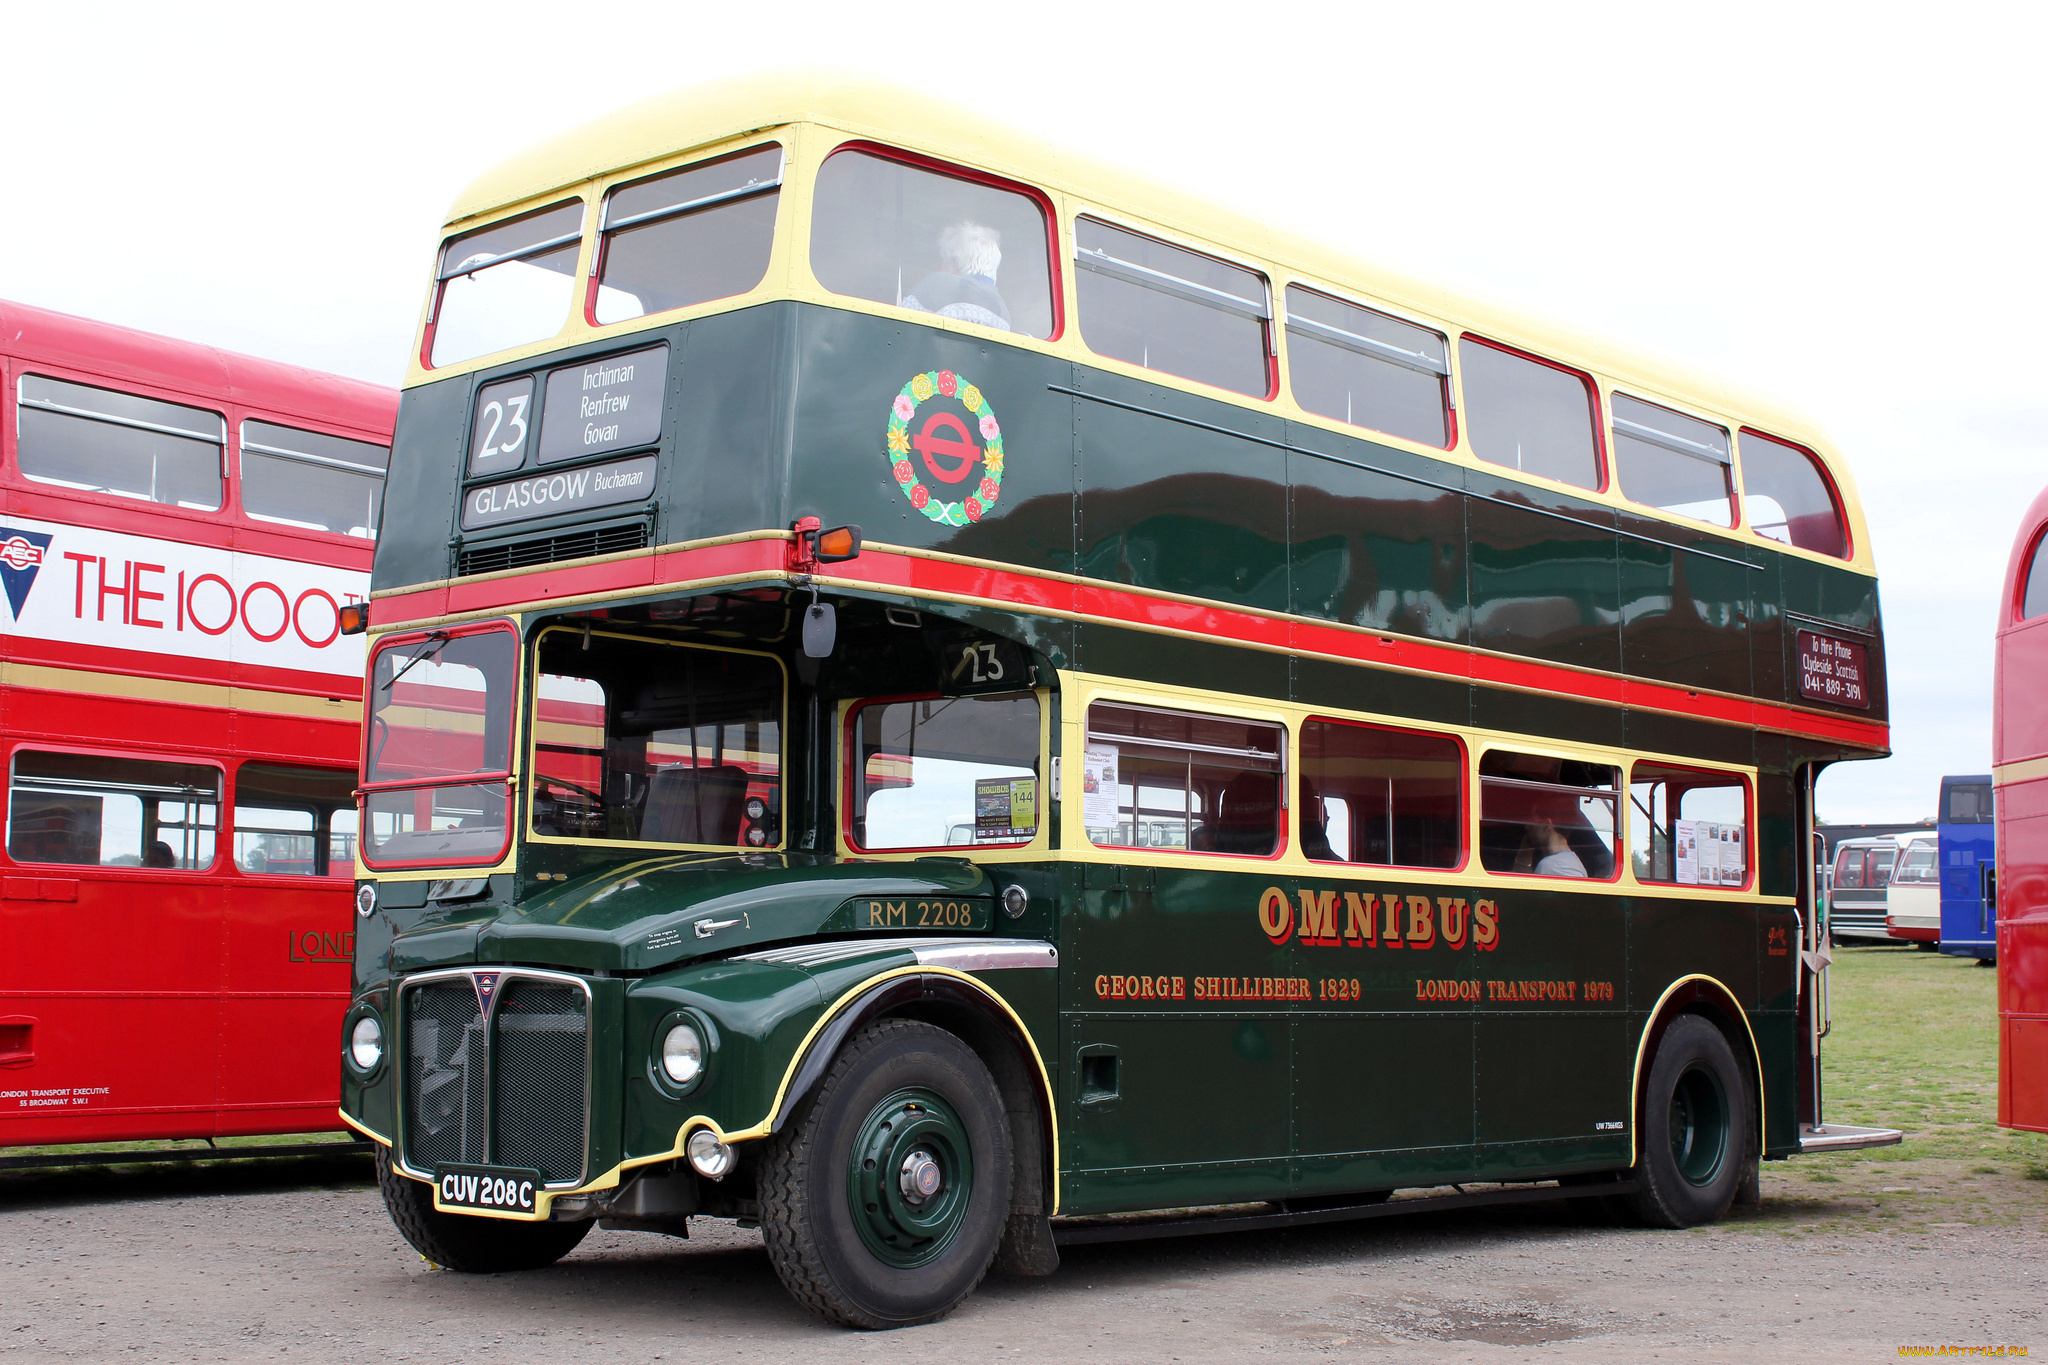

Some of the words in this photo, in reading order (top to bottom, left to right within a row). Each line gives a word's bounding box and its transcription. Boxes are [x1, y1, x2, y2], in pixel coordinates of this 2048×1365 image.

[582, 365, 634, 391] Inchinnan
[580, 392, 631, 418] Renfrew
[478, 394, 529, 458] 23
[584, 422, 619, 445] Govan
[475, 470, 591, 514] GLASGOW
[594, 470, 643, 492] Buchanan
[0, 545, 39, 562] AEC
[63, 551, 165, 629] THE
[1812, 635, 1818, 652] To
[1820, 638, 1832, 656] Hire
[1834, 640, 1852, 659] Phone
[962, 643, 1004, 683] 23
[1802, 653, 1833, 675] Clydeside
[1835, 660, 1859, 681] Scottish
[977, 784, 1010, 795] SHOWBUS
[1013, 791, 1034, 804] 144
[869, 901, 907, 926] RM
[918, 902, 971, 927] 2208
[1258, 886, 1498, 951] OMNIBUS
[1095, 975, 1186, 1000] GEORGE
[1194, 976, 1312, 1001] SHILLIBEER
[1319, 978, 1361, 1001] 1829
[1416, 980, 1482, 1001] LONDON
[1487, 980, 1577, 1001] TRANSPORT
[1583, 981, 1614, 1001] 1979
[29, 1098, 69, 1106] BROADWAY
[31, 1088, 71, 1097] TRANSPORT
[73, 1087, 110, 1096] EXECUTIVE
[441, 1174, 479, 1203] CUV
